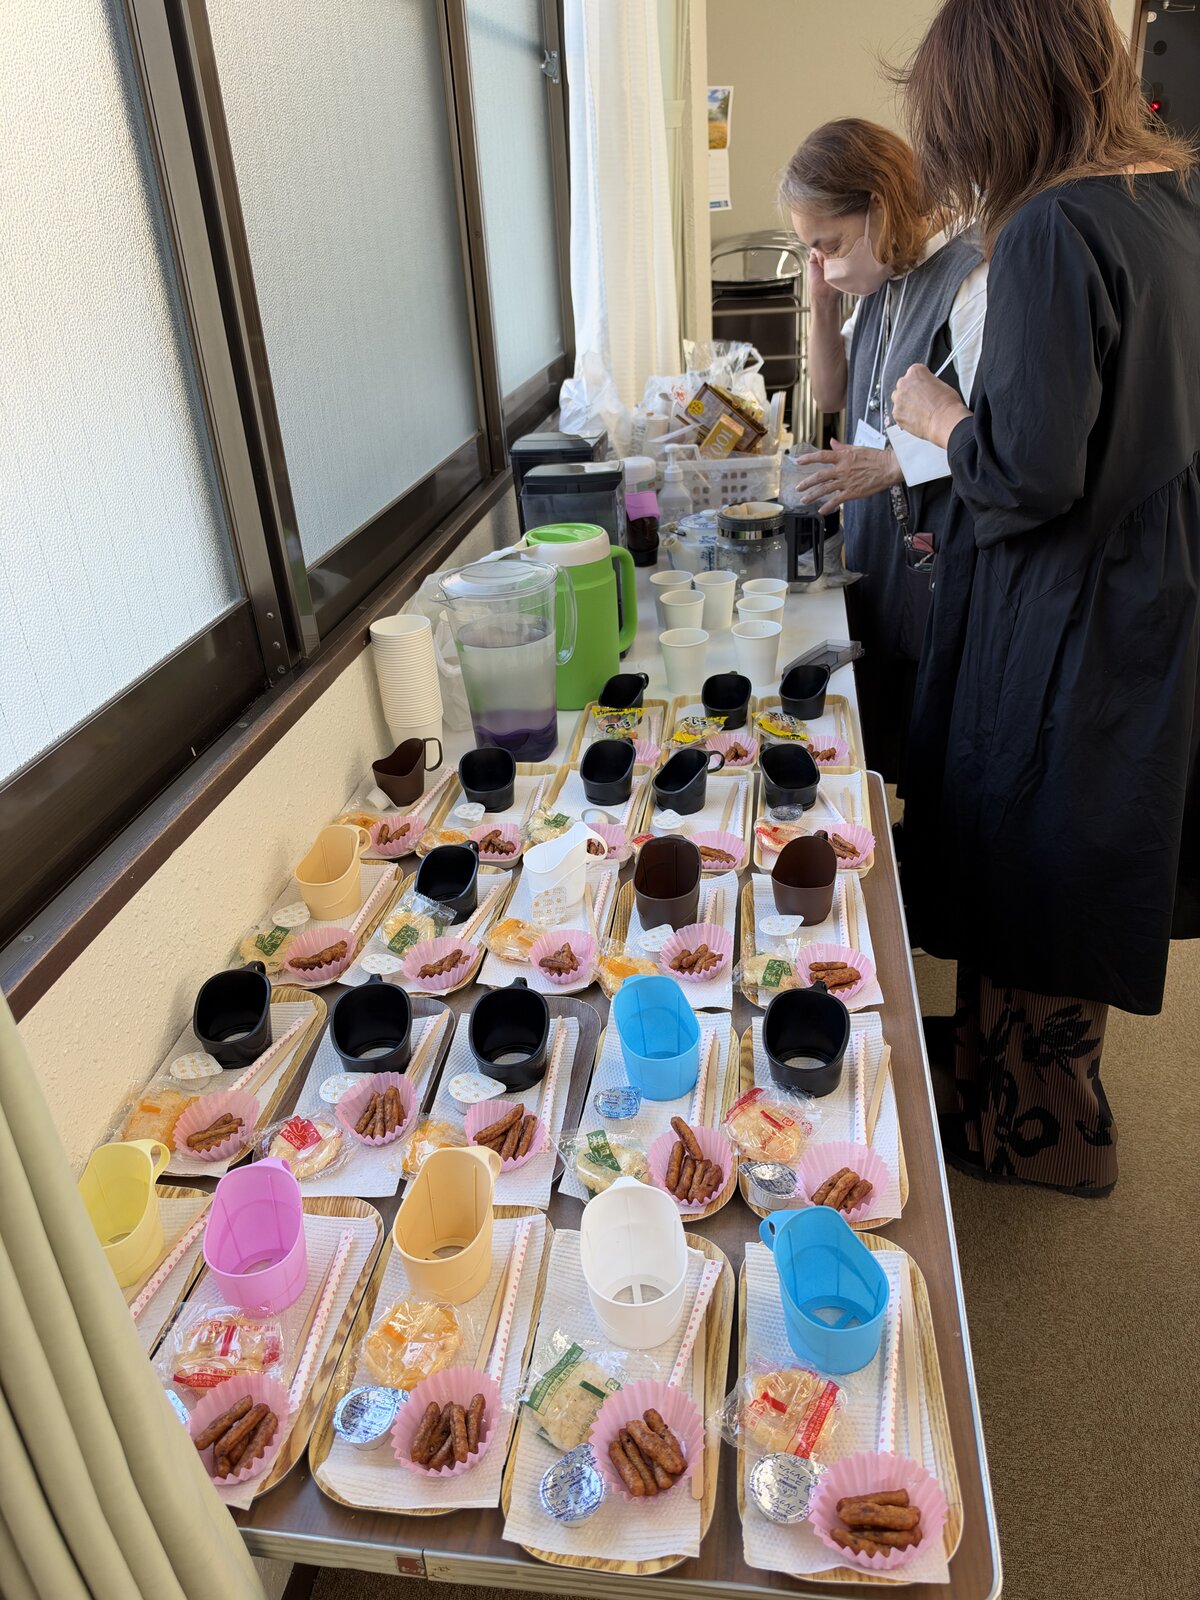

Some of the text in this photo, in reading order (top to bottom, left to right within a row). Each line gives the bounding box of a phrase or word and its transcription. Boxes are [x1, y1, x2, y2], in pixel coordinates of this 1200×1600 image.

[710, 428, 733, 455] 100
[778, 1472, 802, 1486] コーヒー
[779, 1464, 806, 1481] フレッシュ
[769, 1494, 796, 1511] フレッシュ
[769, 1501, 792, 1515] コーヒー
